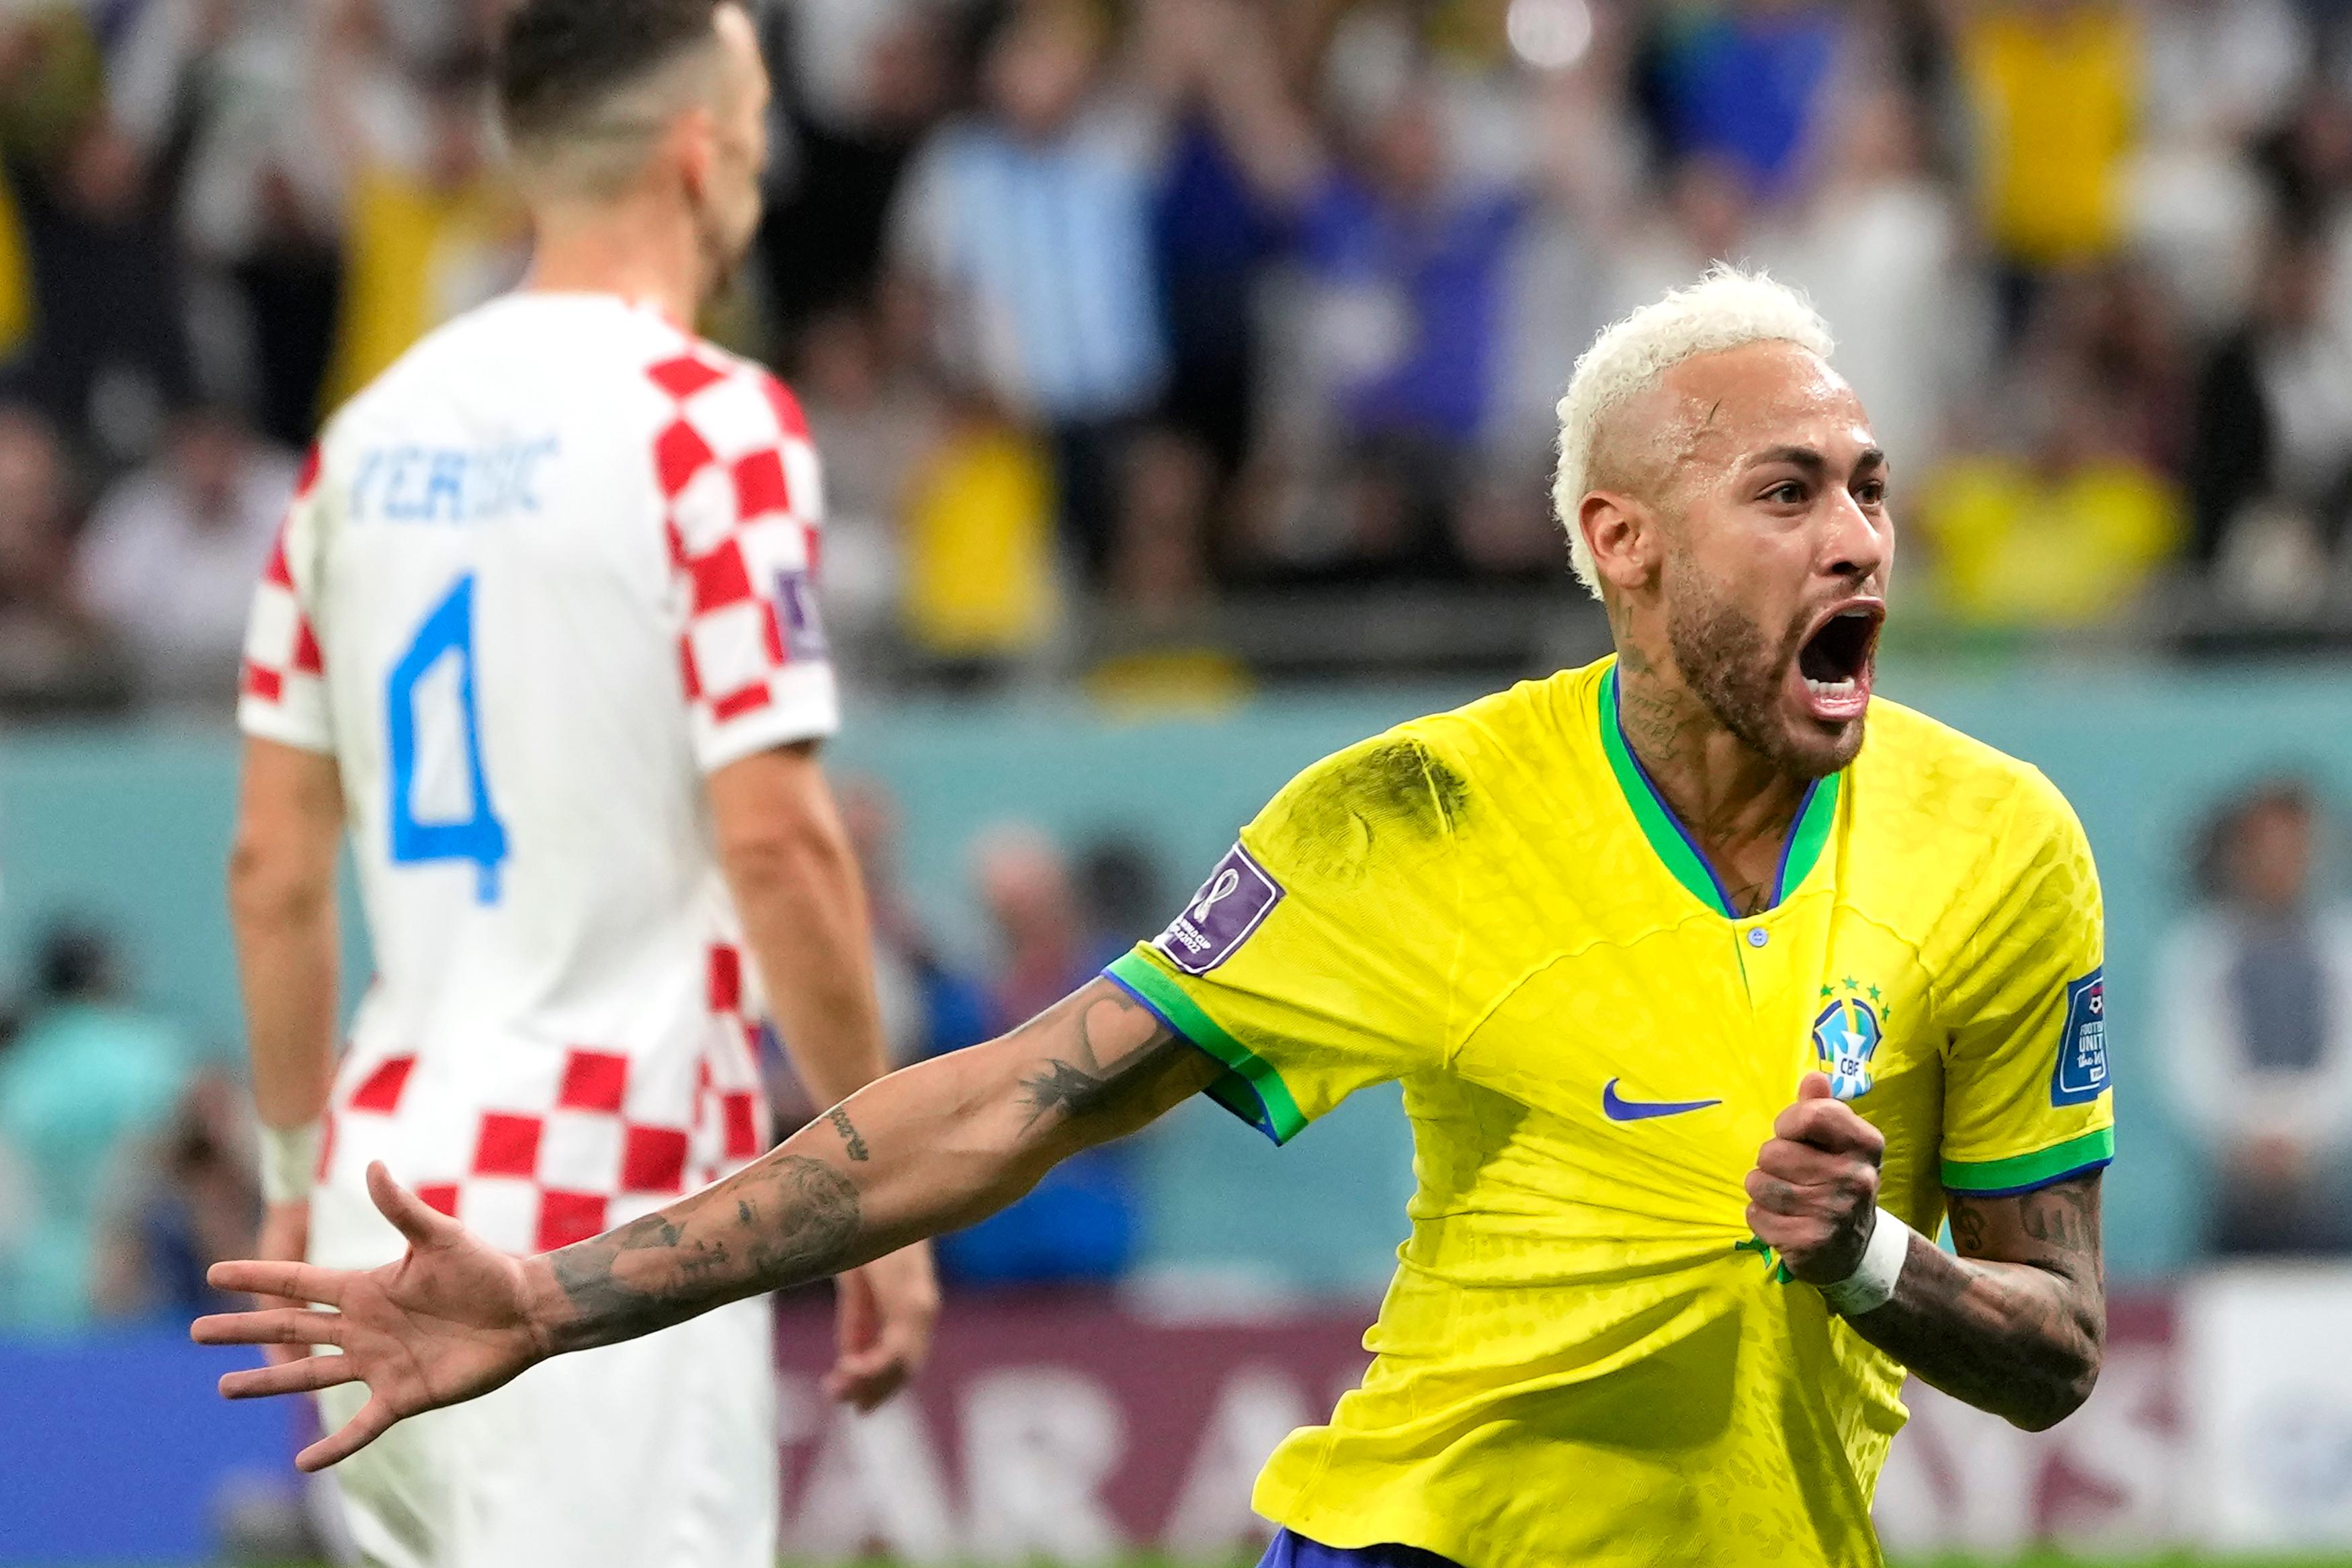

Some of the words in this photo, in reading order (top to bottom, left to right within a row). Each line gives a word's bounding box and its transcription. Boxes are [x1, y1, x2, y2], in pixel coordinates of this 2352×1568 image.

[384, 570, 512, 904] 4
[1194, 934, 1211, 949] CUP
[1841, 1058, 1859, 1076] CBF
